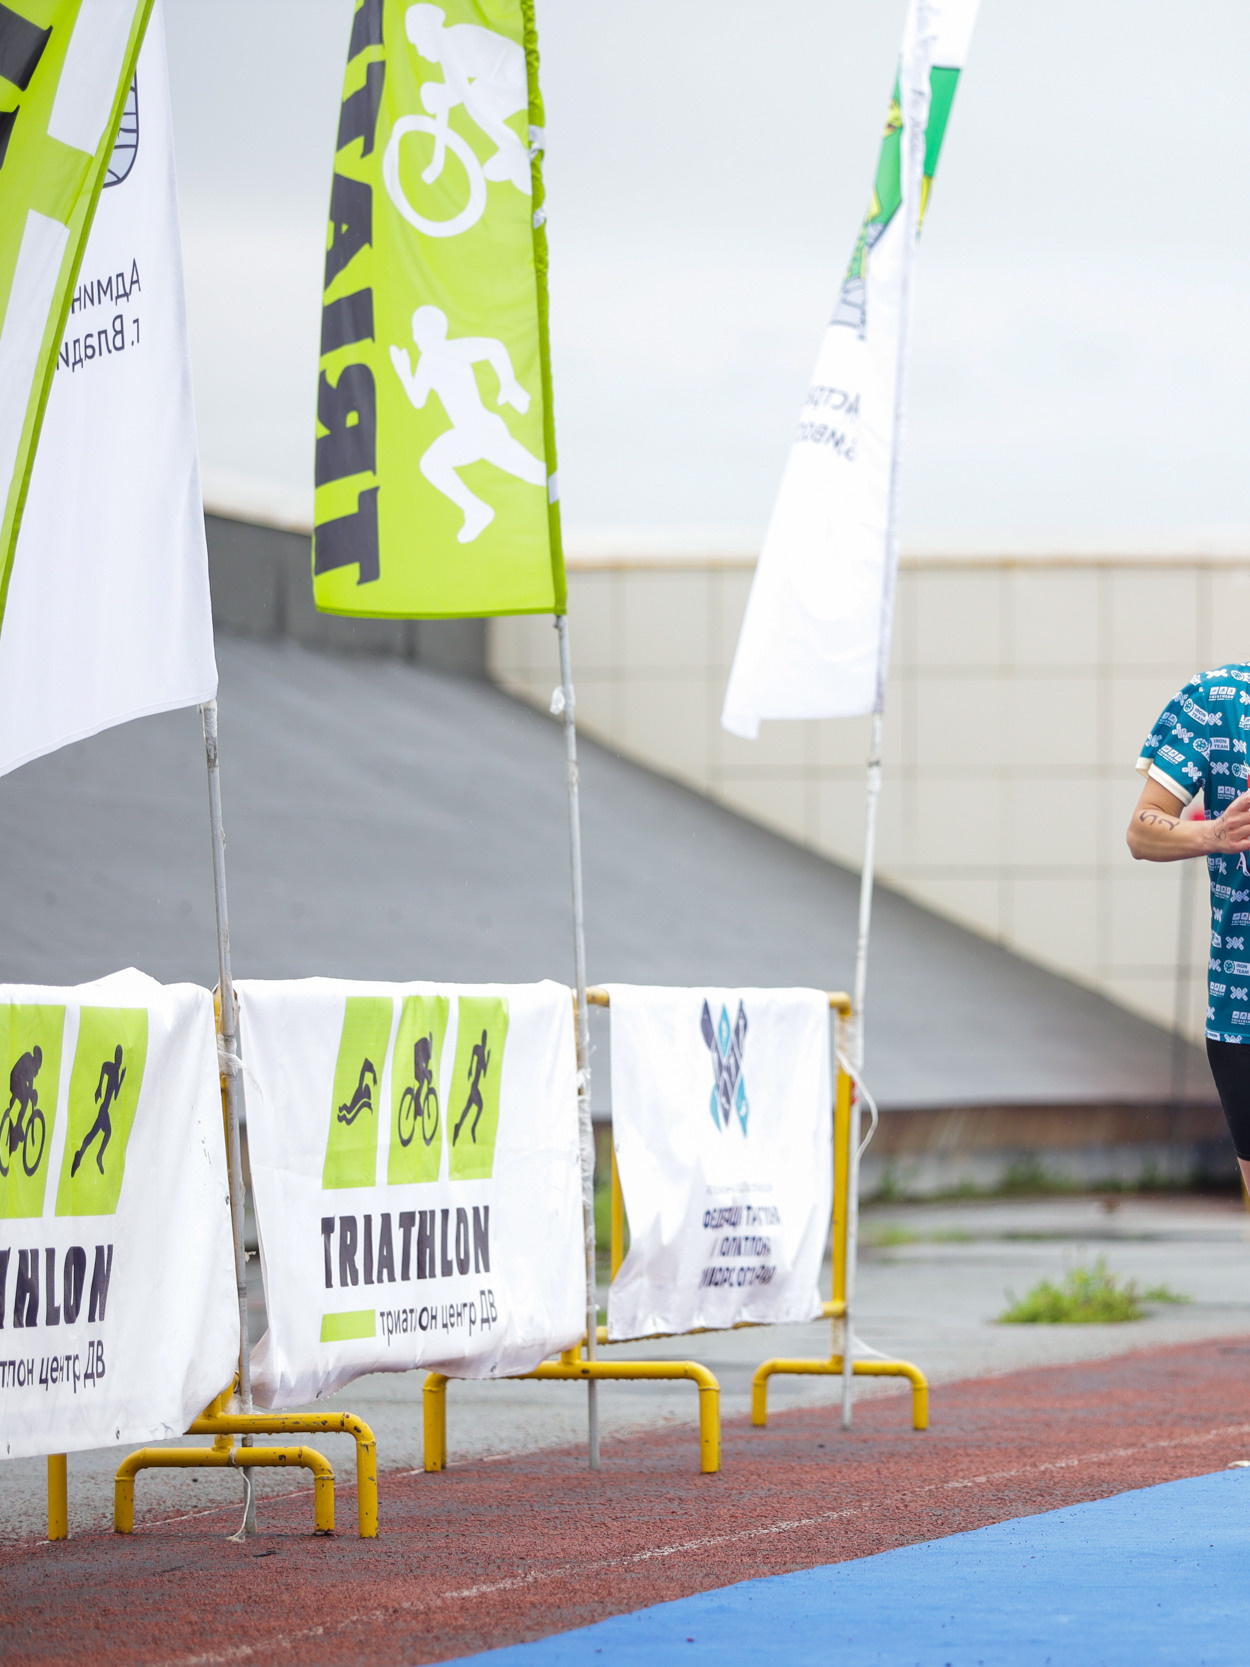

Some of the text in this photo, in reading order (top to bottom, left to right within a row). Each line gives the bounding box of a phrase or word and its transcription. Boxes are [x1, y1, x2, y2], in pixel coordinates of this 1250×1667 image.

[321, 1205, 490, 1288] TRIATHLON
[479, 1289, 498, 1332] ДВ
[39, 1354, 81, 1394] центр
[84, 1340, 106, 1388] ДВ
